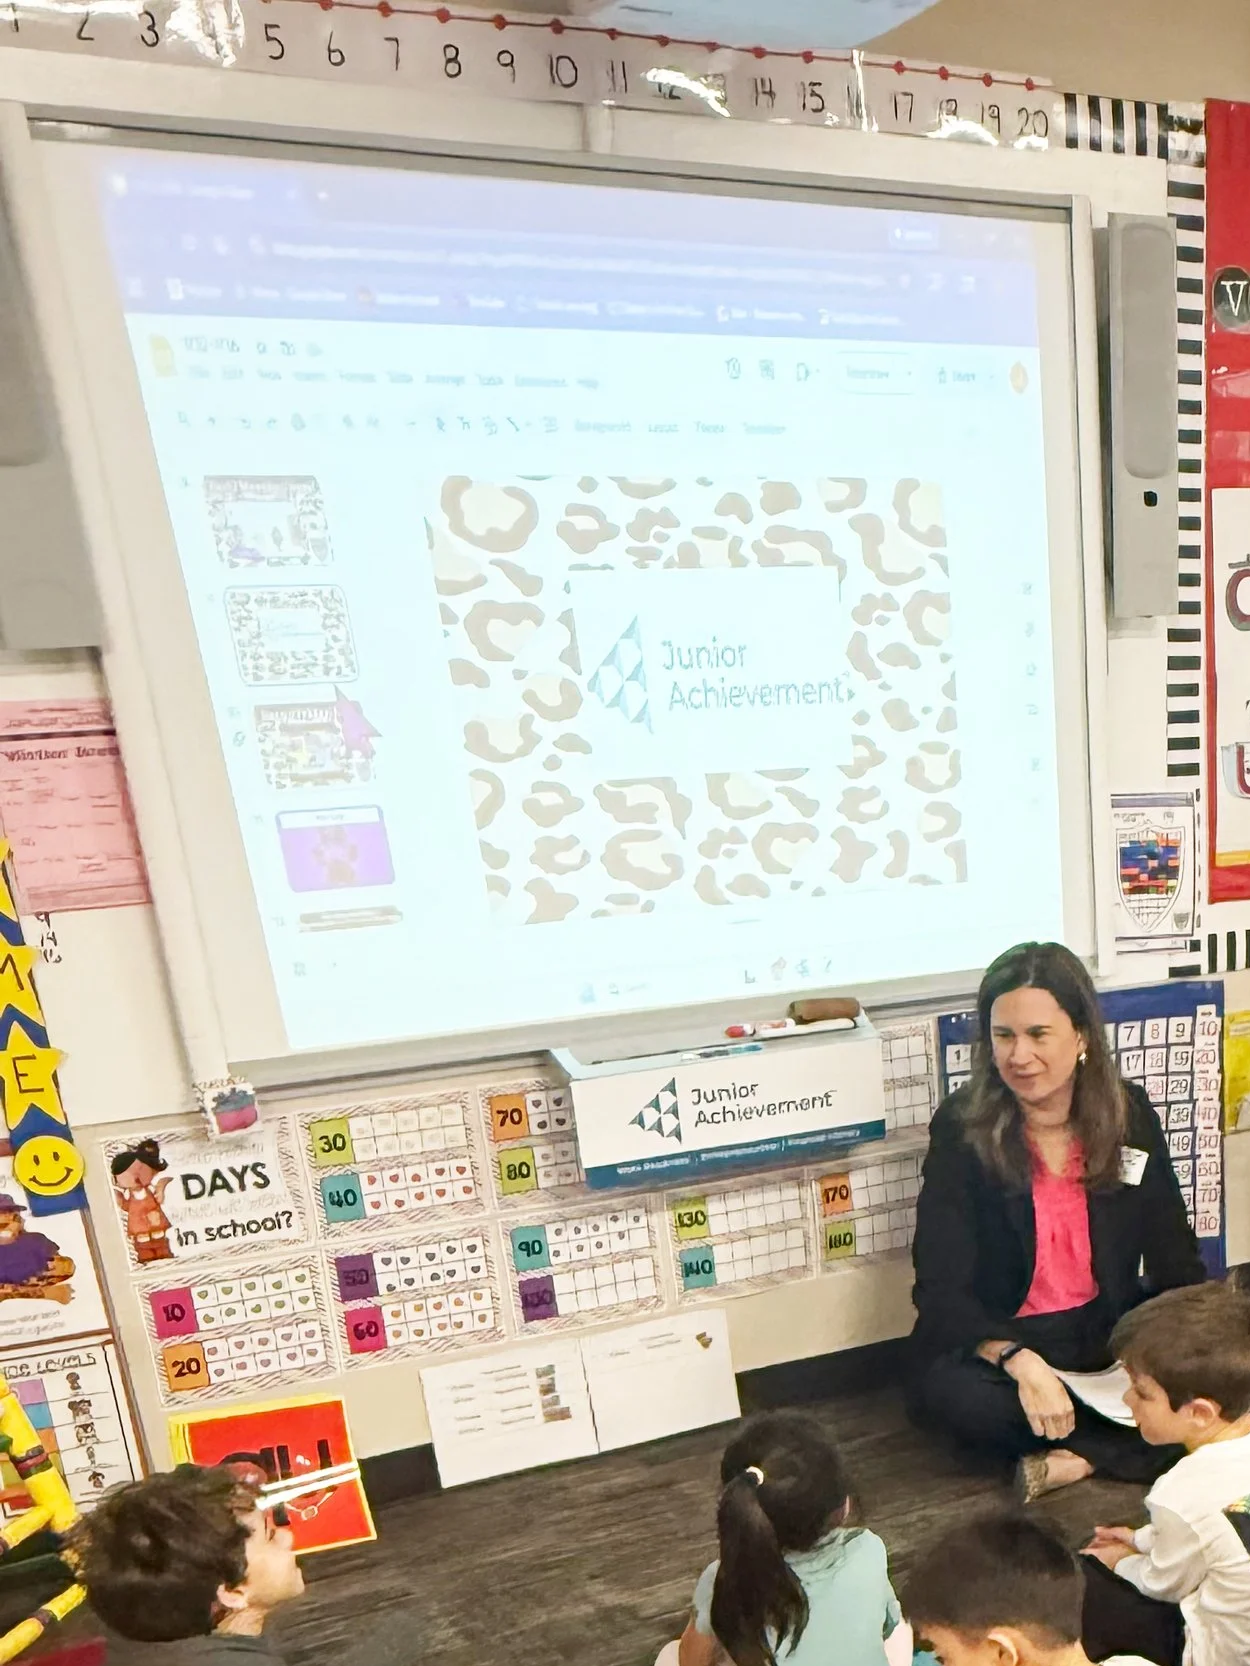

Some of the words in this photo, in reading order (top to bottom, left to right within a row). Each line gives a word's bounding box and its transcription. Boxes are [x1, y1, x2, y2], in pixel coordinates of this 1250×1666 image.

[139, 11, 160, 48] 3
[264, 23, 285, 61] 5
[327, 30, 346, 67] 6
[384, 37, 400, 72] 7
[443, 43, 462, 79] 8
[497, 49, 516, 84] 9
[549, 53, 578, 88] 10
[607, 59, 628, 94] 11
[753, 76, 776, 109] 14
[798, 80, 826, 114] 15
[893, 91, 914, 124] 17
[981, 100, 1001, 135] 19
[1017, 106, 1048, 138] 20
[661, 635, 748, 671] Junior
[669, 676, 845, 711] Achievement
[1123, 1025, 1135, 1042] 7
[1150, 1023, 1160, 1040] 8
[1175, 1022, 1186, 1038] 9
[1199, 1020, 1219, 1037] 10
[1126, 1053, 1142, 1072] 17
[12, 1053, 45, 1095] E
[691, 1082, 760, 1106] Junior
[1168, 1078, 1190, 1096] 29
[496, 1107, 523, 1127] 70
[694, 1093, 834, 1128] Achievement
[318, 1132, 347, 1154] 30
[180, 1161, 271, 1201] DAYS
[506, 1161, 532, 1181] 80
[328, 1188, 358, 1209] 40
[823, 1184, 849, 1204] 170
[175, 1226, 199, 1247] in
[204, 1210, 294, 1242] school?
[517, 1239, 543, 1258] 90
[161, 1302, 186, 1323] 10
[353, 1319, 379, 1341] 60
[171, 1356, 201, 1379] 20
